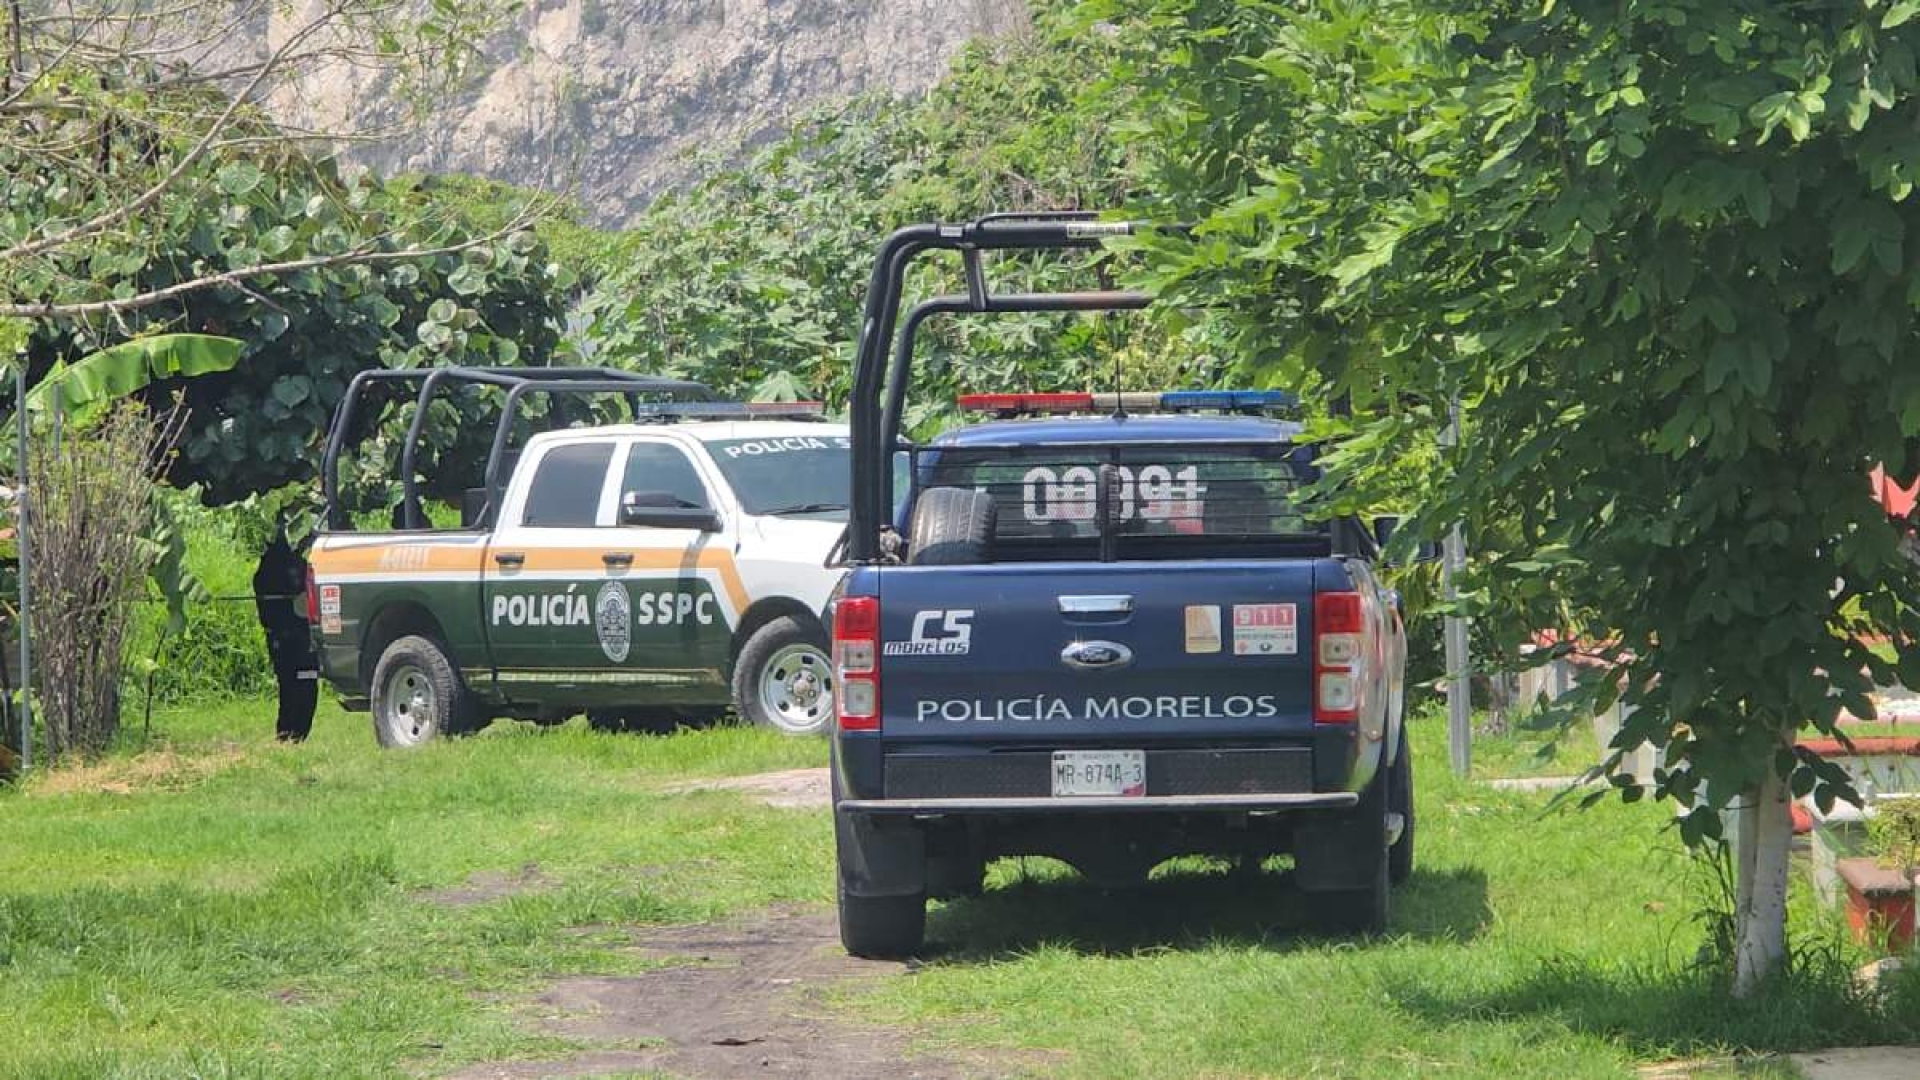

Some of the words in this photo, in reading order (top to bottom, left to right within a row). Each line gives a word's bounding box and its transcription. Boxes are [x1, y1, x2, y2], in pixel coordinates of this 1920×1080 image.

[492, 584, 590, 625] POLICÍA
[638, 592, 713, 625] SSPC
[1238, 607, 1289, 625] 911
[917, 694, 1073, 722] POLICÍA
[1085, 695, 1278, 719] MORELOS
